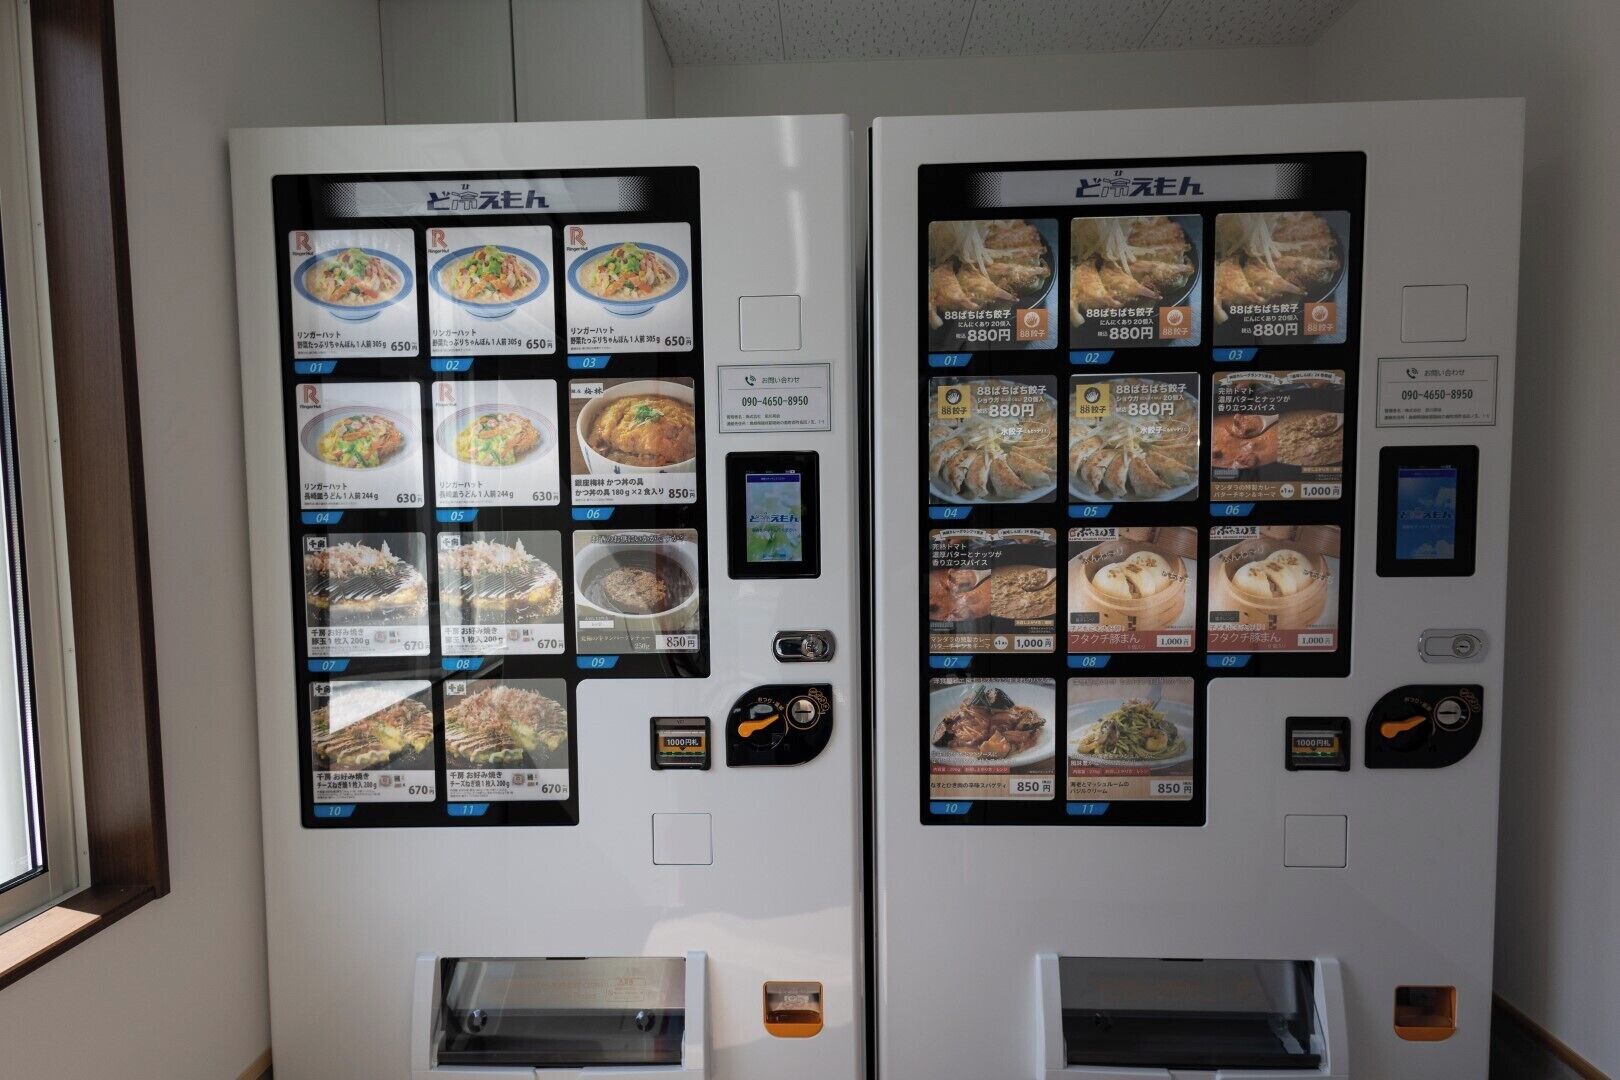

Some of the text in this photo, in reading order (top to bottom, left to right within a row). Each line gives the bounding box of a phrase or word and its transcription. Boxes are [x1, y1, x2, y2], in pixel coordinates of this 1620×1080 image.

[1076, 176, 1204, 198] ど冷えもん
[427, 189, 549, 211] ど冷えもん
[432, 329, 476, 337] リンガーハット
[570, 326, 615, 335] リンガーハット
[1109, 327, 1153, 340] 880円
[1253, 323, 1298, 336] 880円
[297, 331, 341, 339] リンガーハット
[967, 329, 1011, 342] 880円
[1085, 353, 1100, 363] 02
[1229, 351, 1243, 360] 03
[446, 361, 460, 370] 02
[583, 358, 596, 368] 03
[944, 356, 958, 366] 01
[310, 363, 323, 372] 01
[1424, 369, 1465, 377] お問い合わせ
[1402, 389, 1473, 400] 090-4650-8950
[741, 395, 809, 407] 090-4650-8950
[989, 404, 1035, 417] 880円
[1128, 402, 1174, 416] 880円
[304, 482, 347, 491] リンガーハット
[439, 481, 483, 489] リンガーハット
[586, 509, 601, 519] 06
[944, 508, 958, 518] 04
[1084, 507, 1098, 517] 05
[1225, 505, 1240, 515] 06
[316, 513, 330, 523] 04
[450, 511, 465, 521] 05
[322, 661, 336, 670] 07
[456, 659, 470, 669] 08
[591, 658, 605, 667] 09
[944, 657, 958, 667] 07
[1082, 656, 1097, 667] 08
[1222, 655, 1237, 666] 09
[666, 738, 699, 746] 1000円札
[1296, 739, 1331, 747] 1000円札
[1017, 782, 1051, 793] 850円
[329, 807, 341, 816] 10
[945, 803, 958, 813] 10
[1082, 804, 1094, 814] 11
